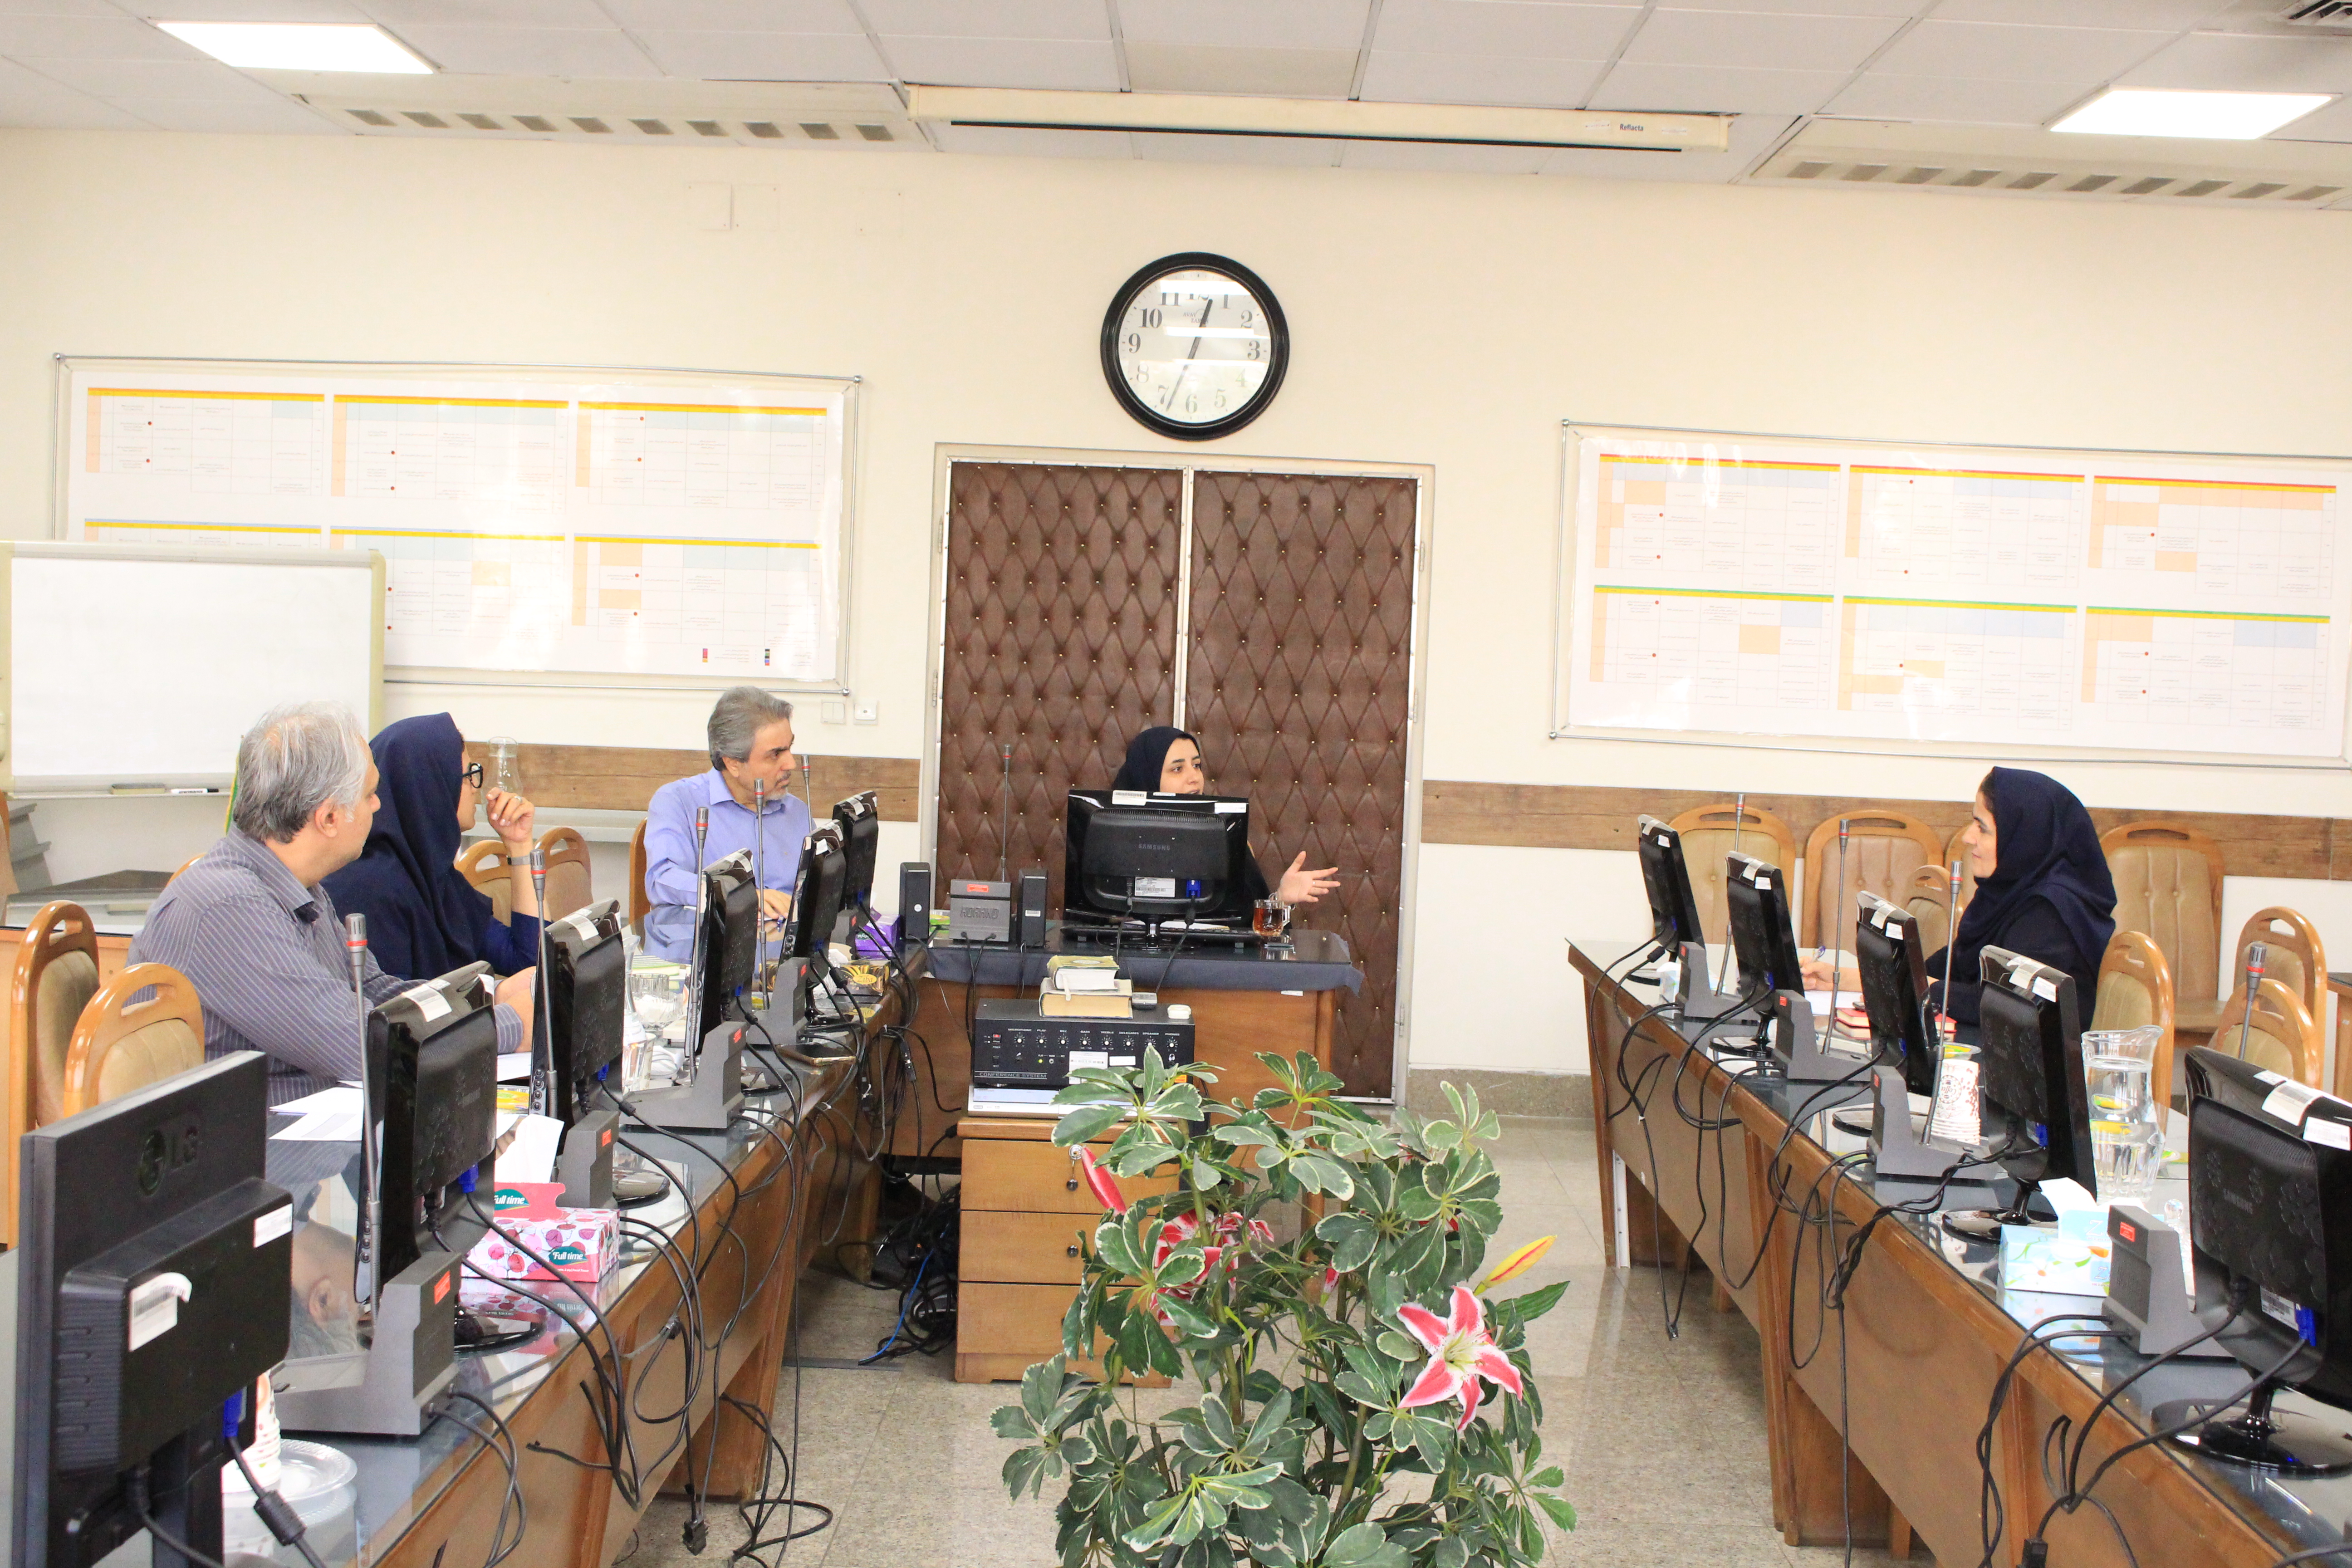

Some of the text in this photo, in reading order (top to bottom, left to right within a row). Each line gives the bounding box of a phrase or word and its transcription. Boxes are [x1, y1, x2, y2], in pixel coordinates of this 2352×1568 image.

[1138, 308, 1162, 328] 10
[1241, 310, 1253, 328] 2
[1128, 333, 1141, 353] 9
[1248, 340, 1260, 360] 3
[1136, 364, 1149, 383] 8
[1235, 368, 1247, 387] 4
[1158, 385, 1170, 405] 7
[1186, 394, 1198, 414] 6
[1214, 389, 1226, 408] 5
[1940, 1086, 1956, 1095] Coffee
[170, 1126, 199, 1168] LG
[494, 1195, 525, 1205] Full time
[553, 1251, 583, 1260] Full time
